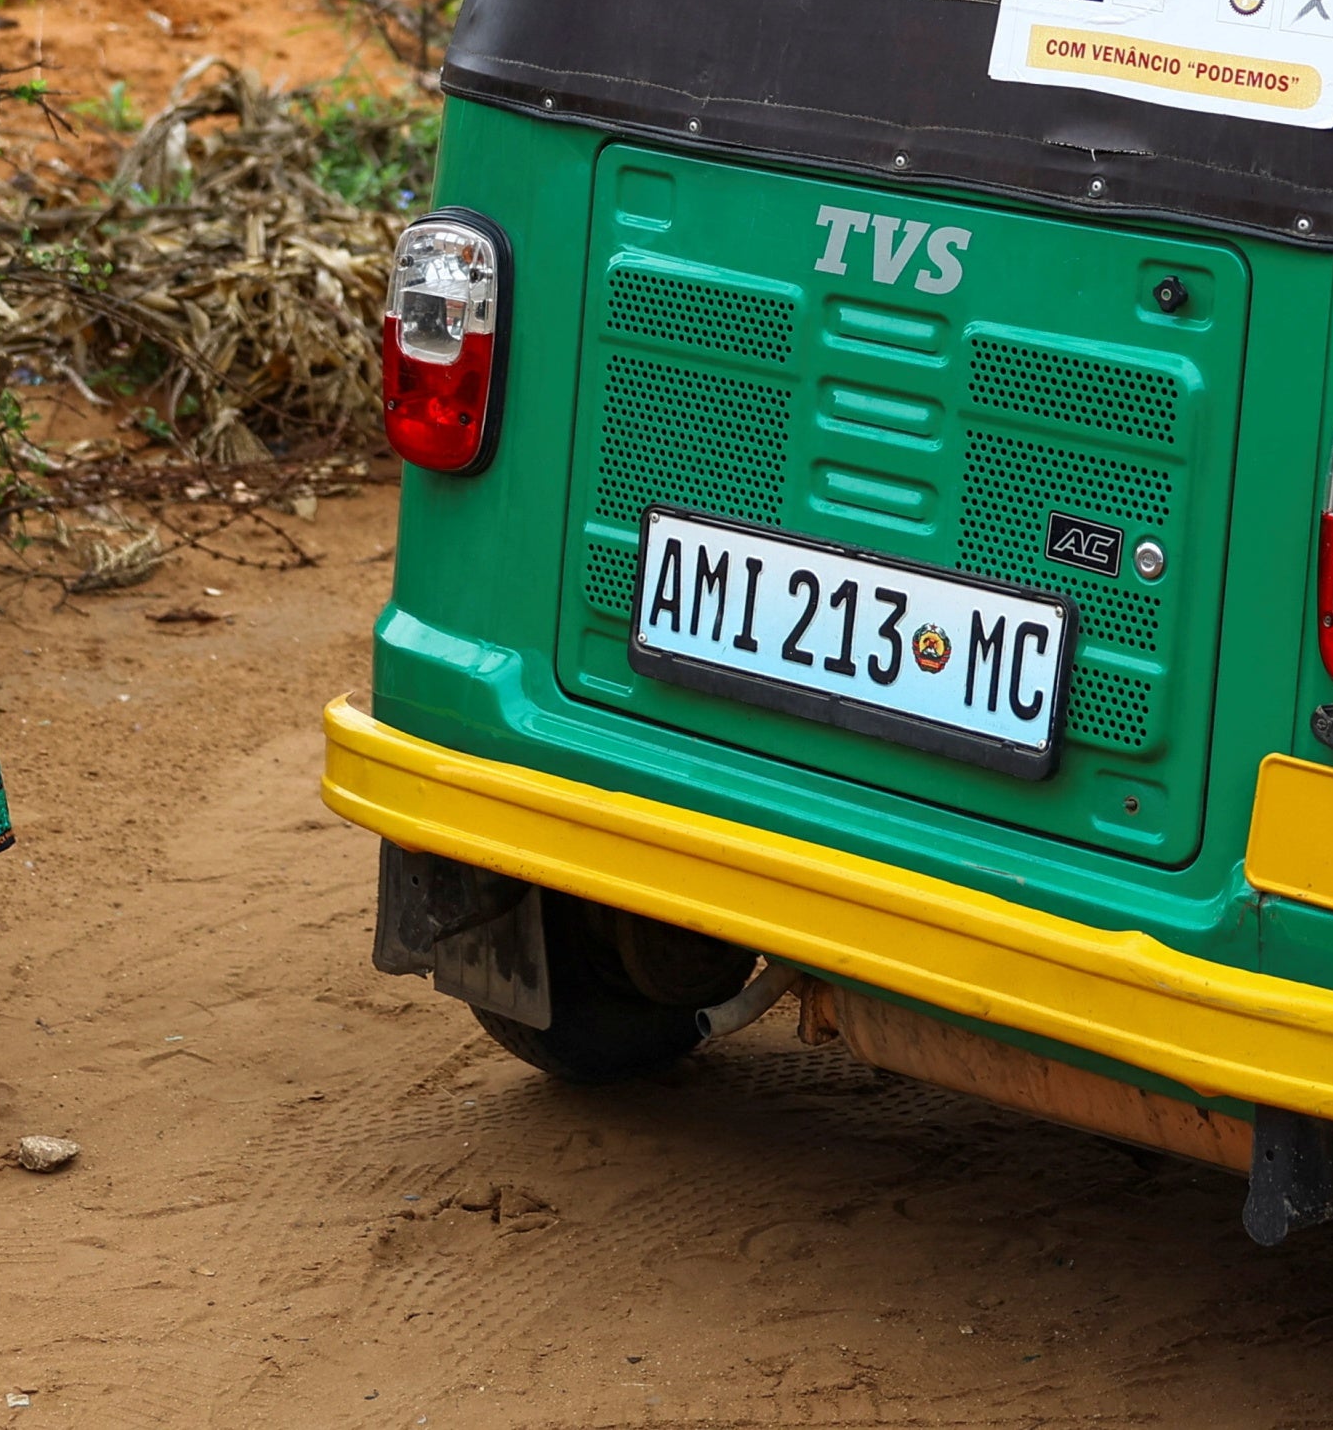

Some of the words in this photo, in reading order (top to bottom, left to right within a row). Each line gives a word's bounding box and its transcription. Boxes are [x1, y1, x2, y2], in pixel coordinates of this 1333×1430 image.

[1046, 38, 1087, 63] COM
[1091, 41, 1182, 78] VENÂNCIO
[814, 204, 973, 296] TVS
[1052, 527, 1116, 564] AC
[648, 538, 764, 653] AMI
[781, 568, 910, 685] 213
[963, 609, 1049, 721] MC
